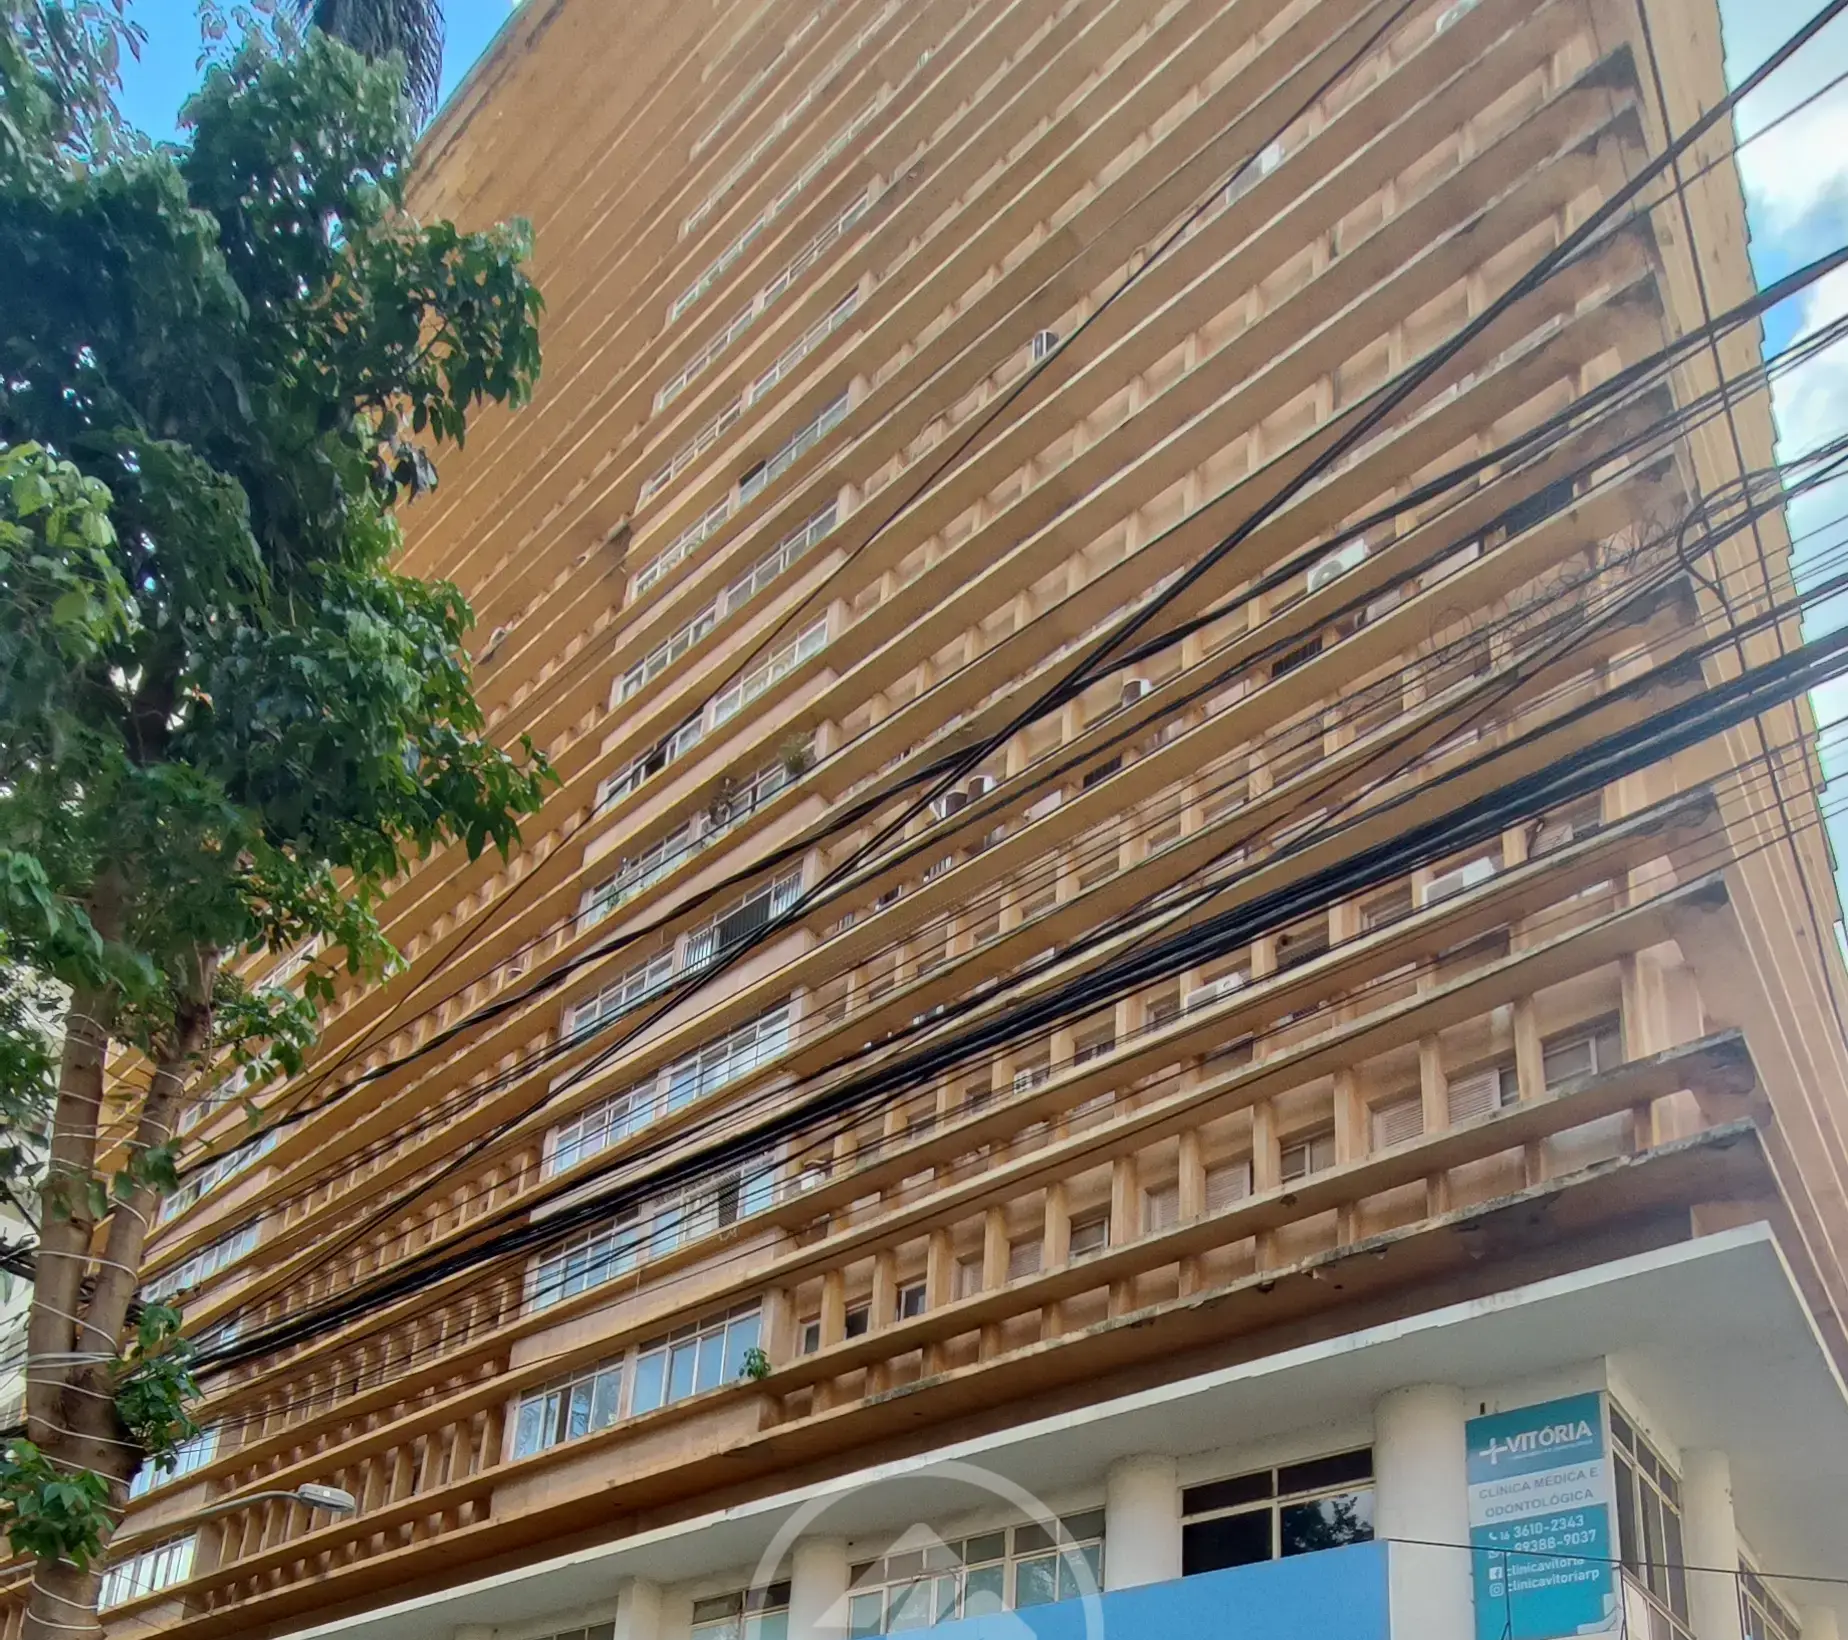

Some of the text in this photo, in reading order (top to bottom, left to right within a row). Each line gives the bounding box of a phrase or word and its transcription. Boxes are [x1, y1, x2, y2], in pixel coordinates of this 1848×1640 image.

[1506, 1420, 1593, 1453] VITÓRIA
[1590, 1466, 1599, 1478] E
[1485, 1488, 1594, 1518] ODONTOLÓGICA
[1513, 1514, 1585, 1538] 3610-2343
